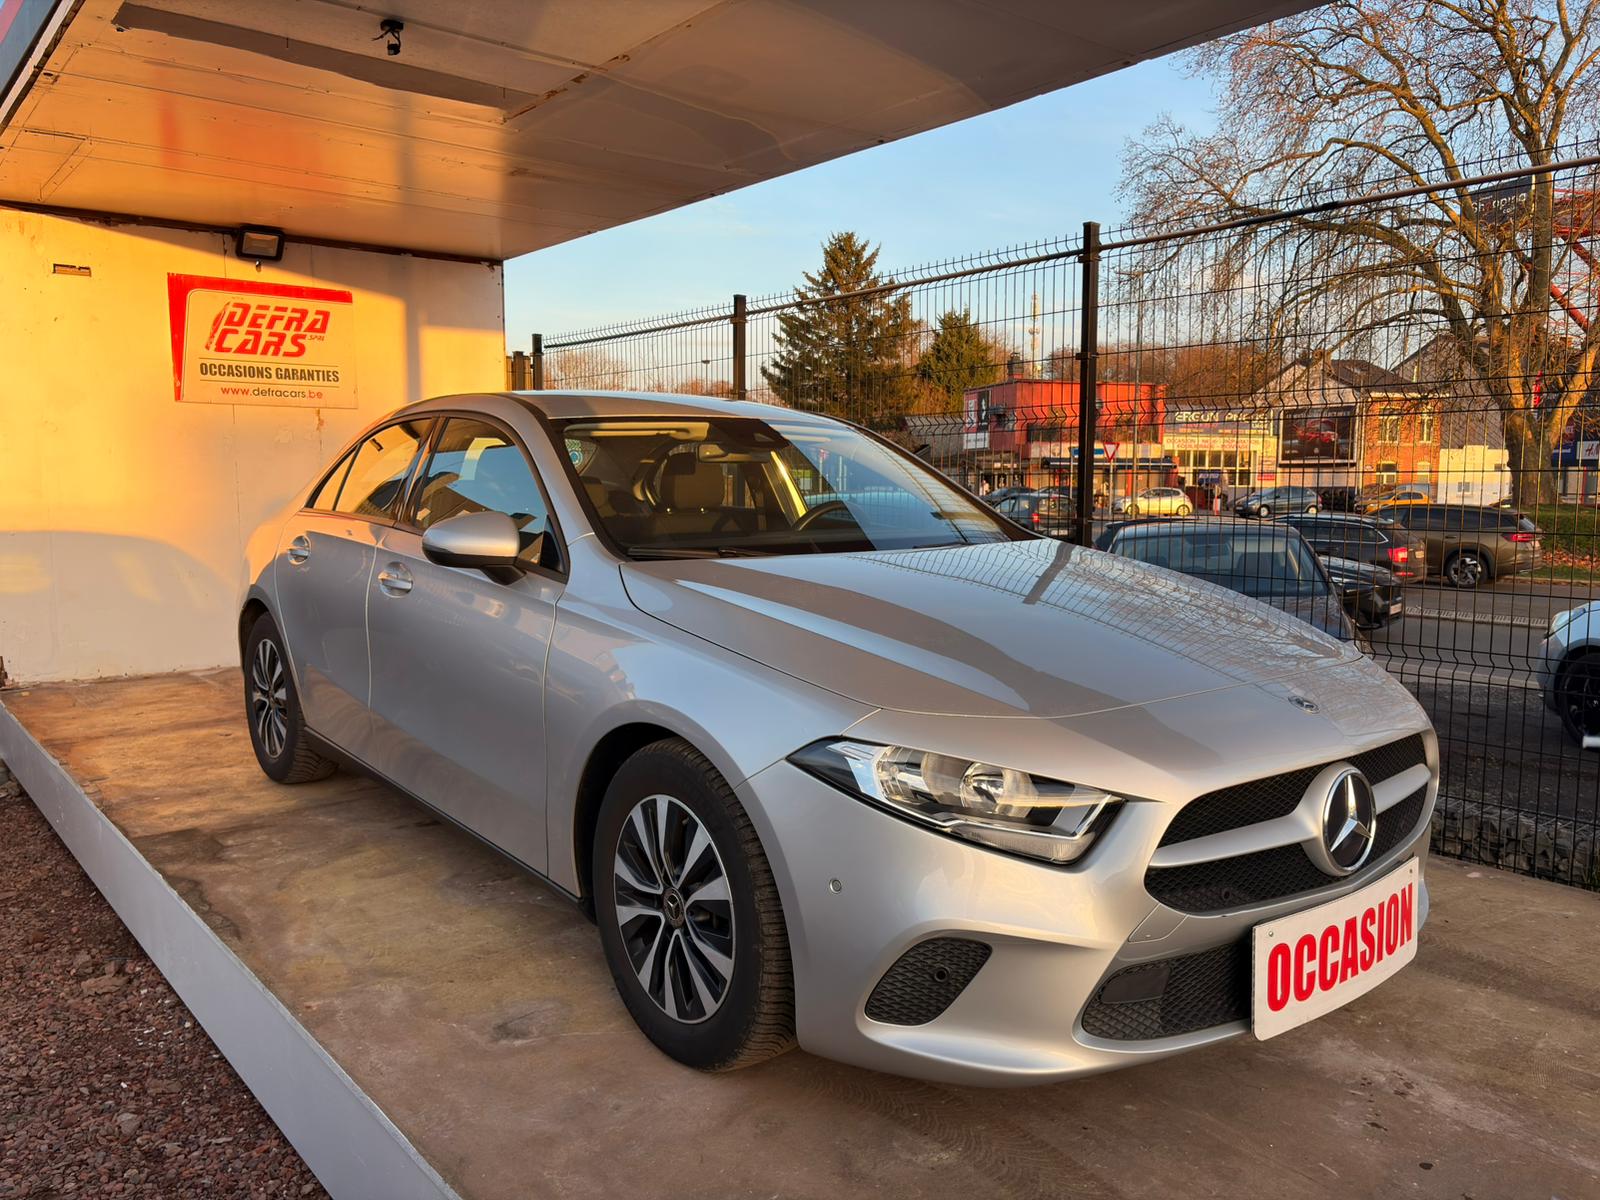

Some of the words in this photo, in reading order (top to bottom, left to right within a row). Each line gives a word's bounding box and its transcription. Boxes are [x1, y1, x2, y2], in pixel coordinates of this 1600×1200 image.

[224, 302, 331, 334] DEFRA
[214, 328, 306, 358] CARS
[199, 362, 272, 380] OCCASIONS
[275, 366, 340, 383] GARANTIES
[220, 386, 323, 400] www.defracars.be
[1266, 882, 1413, 1012] OCCASION
